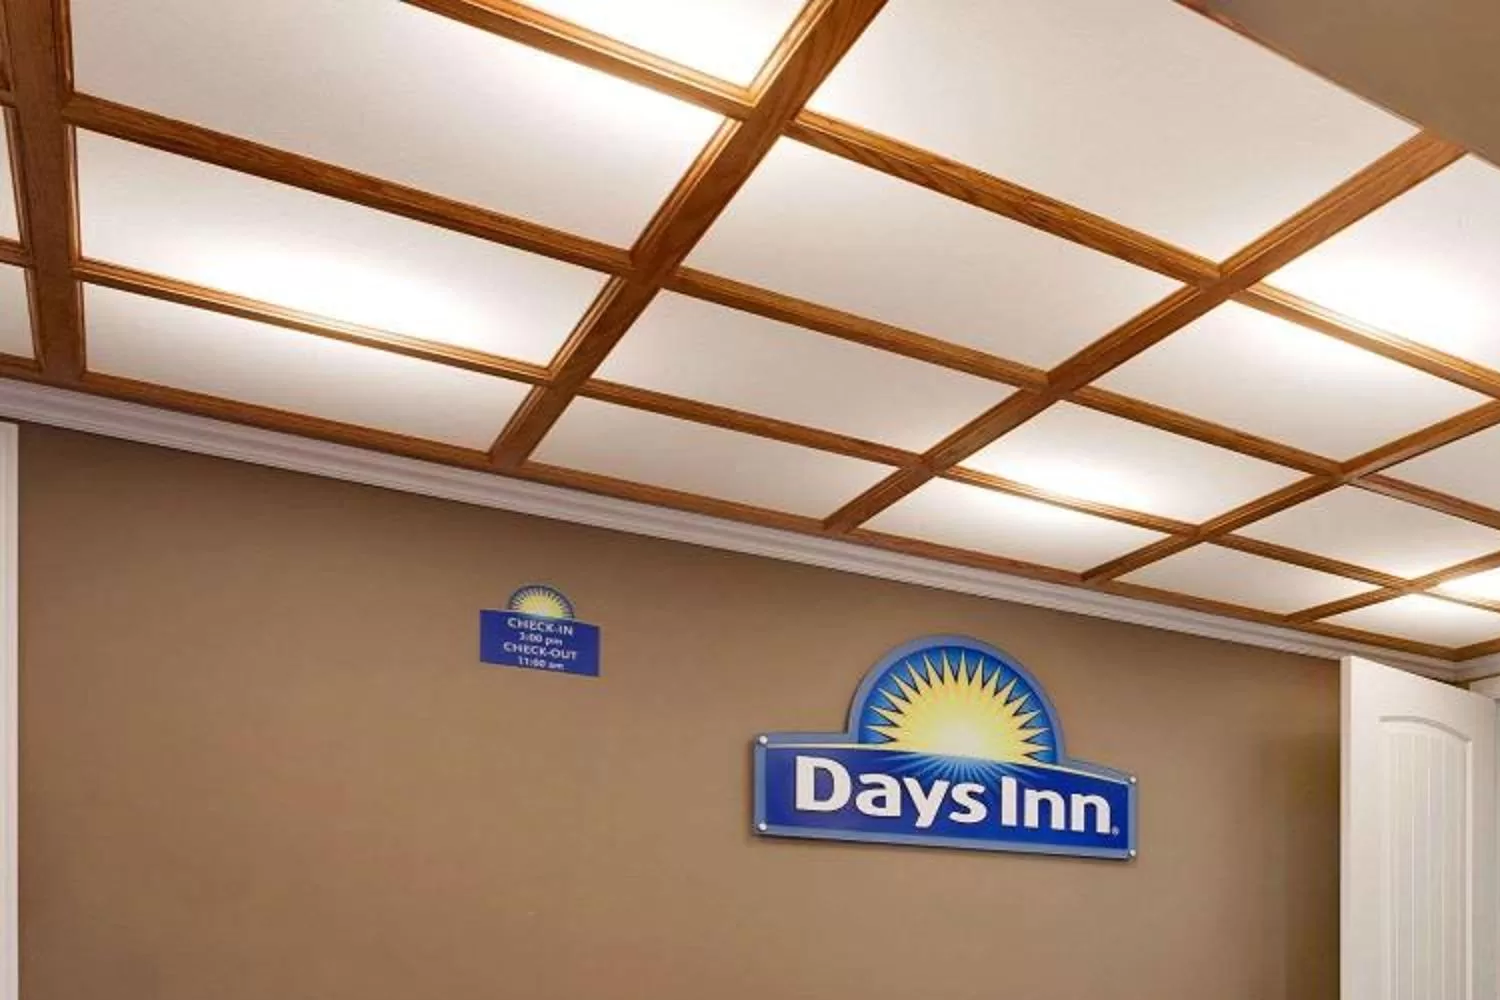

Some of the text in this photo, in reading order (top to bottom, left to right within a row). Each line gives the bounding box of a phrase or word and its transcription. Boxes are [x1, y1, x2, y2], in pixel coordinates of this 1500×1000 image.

[507, 617, 573, 636] CHECK-IN
[503, 641, 577, 661] CHECK-OUT
[794, 754, 1111, 836] Days Inn
